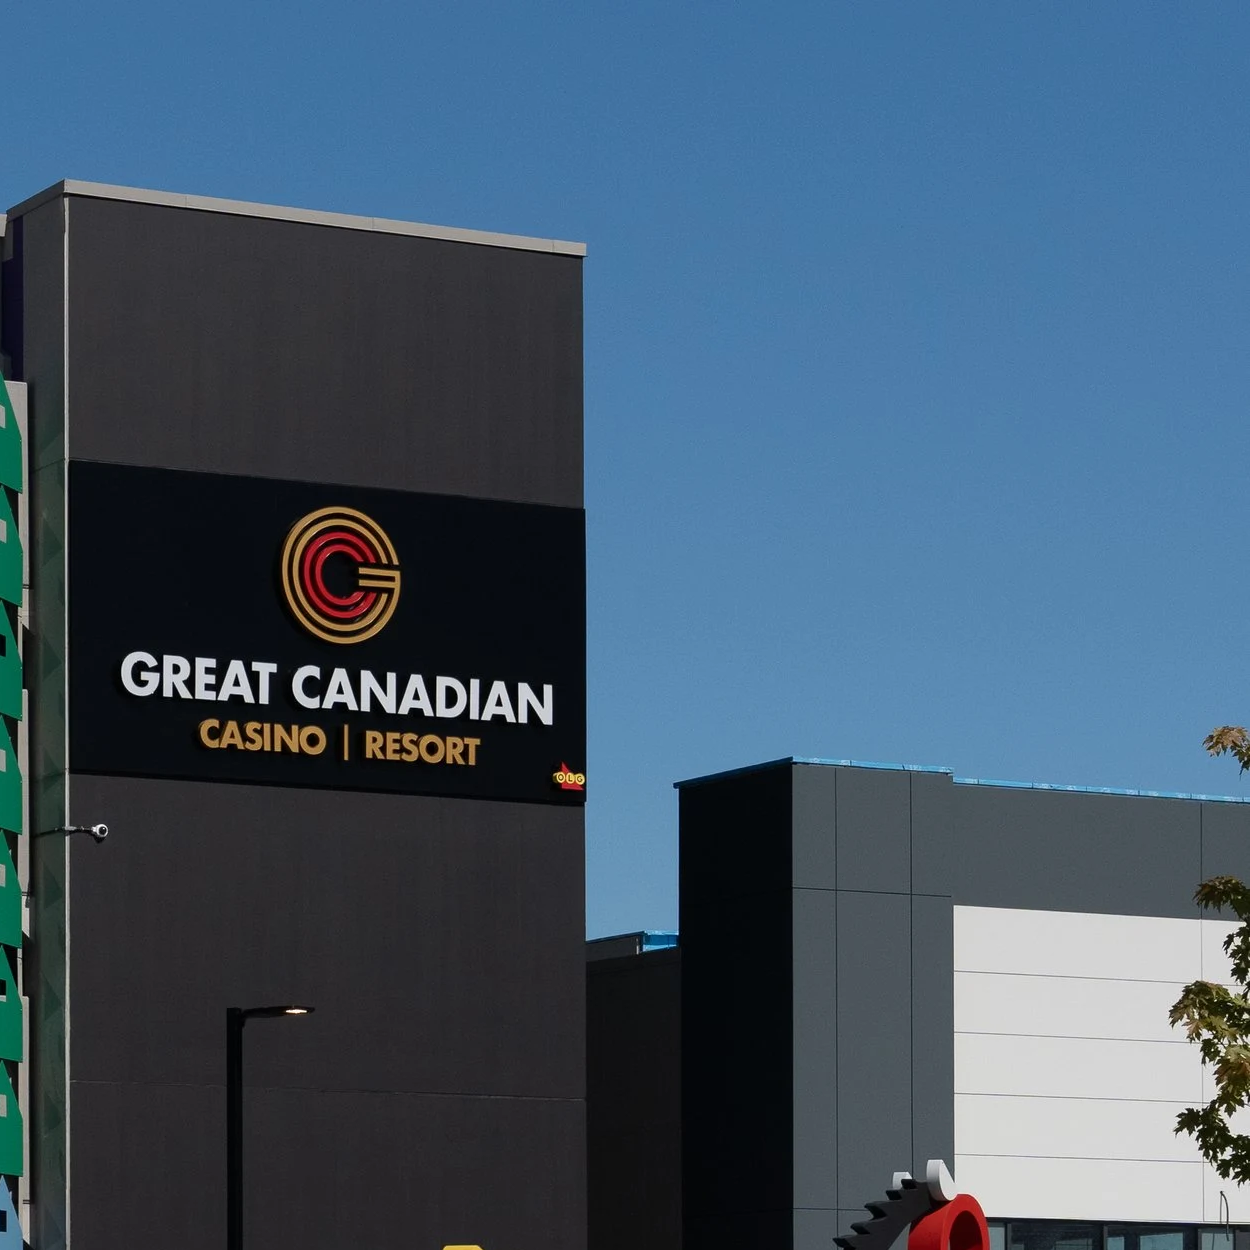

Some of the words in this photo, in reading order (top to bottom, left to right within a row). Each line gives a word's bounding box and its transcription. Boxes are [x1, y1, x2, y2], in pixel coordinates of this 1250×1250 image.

[121, 650, 278, 704] GREAT
[292, 664, 554, 725] CANADIAN
[199, 719, 327, 756] CASINO
[365, 731, 481, 766] RESORT
[557, 773, 584, 784] OLG
